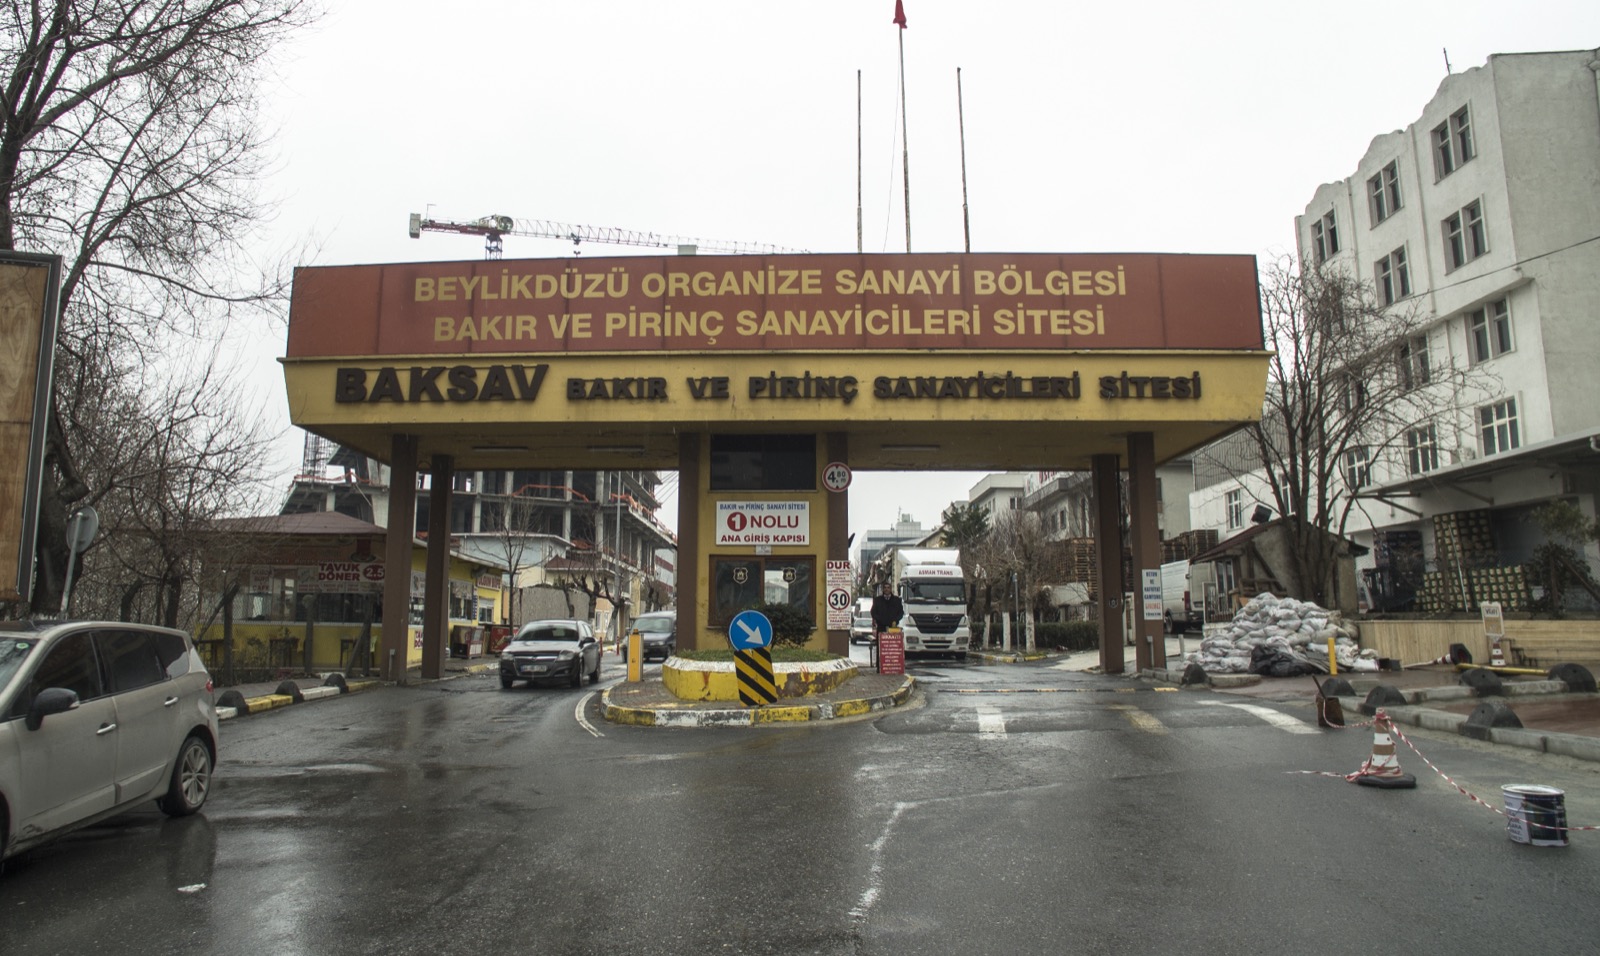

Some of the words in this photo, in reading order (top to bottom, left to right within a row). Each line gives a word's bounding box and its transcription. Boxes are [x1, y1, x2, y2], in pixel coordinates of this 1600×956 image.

[414, 268, 629, 302] BEYLİKDÜZÜ
[641, 265, 823, 298] ORGANİZE
[836, 264, 960, 296] SANAYİ
[974, 264, 1126, 296] BÖLGESİ
[433, 315, 537, 342] BAKIR
[548, 313, 593, 340] VE
[605, 305, 724, 345] PİRİNÇ
[736, 304, 981, 336] SANAYİCİLERİ
[993, 303, 1106, 336] SİTESİ
[335, 363, 549, 403] BAKSAV
[566, 377, 668, 400] BAKIR
[687, 376, 730, 399] VE
[748, 370, 859, 404] PİRİNÇ
[873, 370, 1081, 400] SANAYİCİLERİ
[1099, 370, 1202, 399] SİTESİ
[745, 503, 764, 511] PİRİNÇ
[750, 515, 799, 528] NOLU
[744, 533, 770, 543] GİRİŞ
[318, 562, 360, 572] TAVUK
[318, 571, 361, 581] DÖNER
[831, 593, 847, 606] 30
